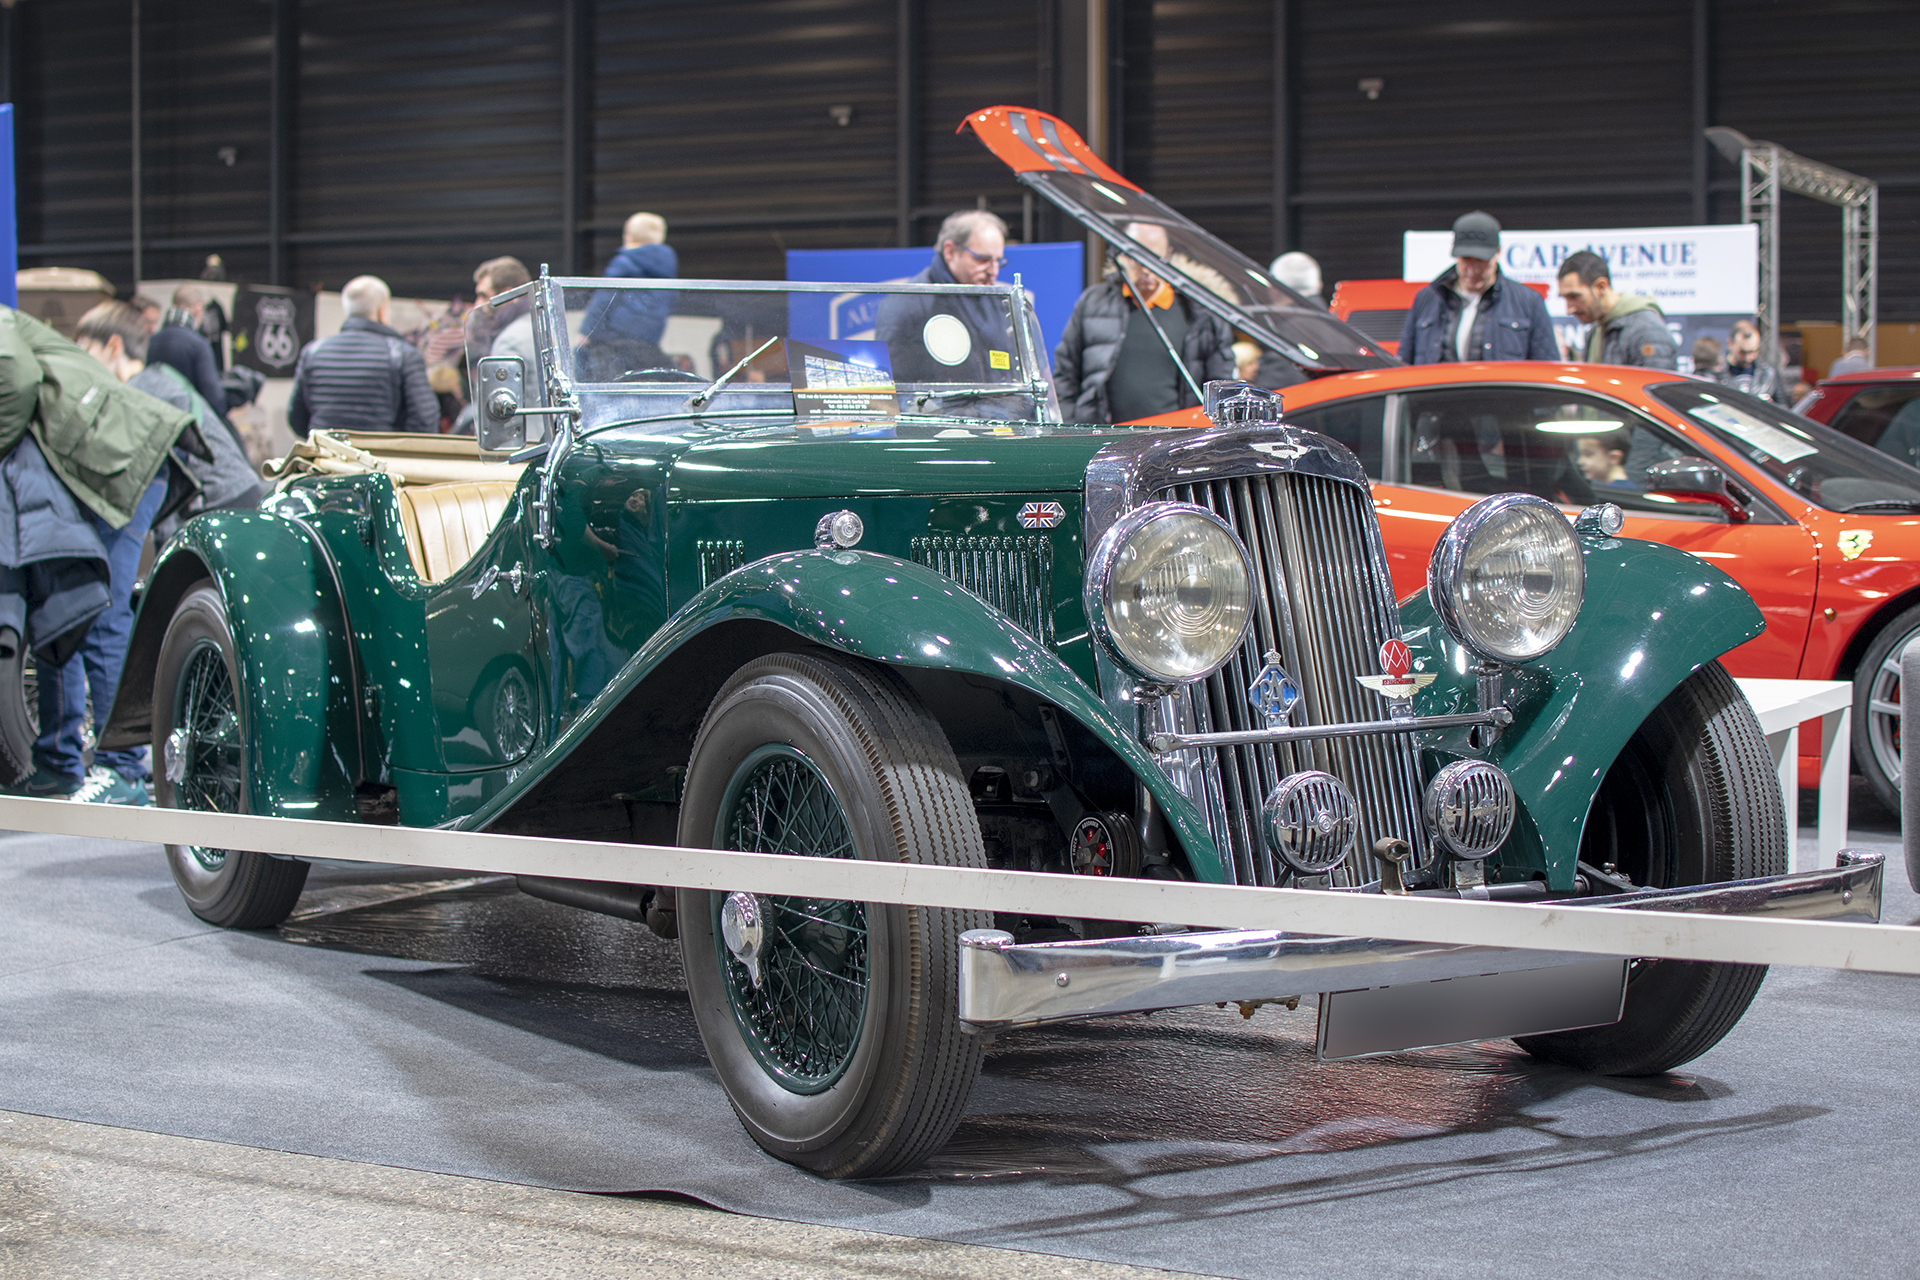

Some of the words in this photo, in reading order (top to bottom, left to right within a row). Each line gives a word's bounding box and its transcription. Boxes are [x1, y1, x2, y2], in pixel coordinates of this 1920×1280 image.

[1507, 243, 1568, 268] CAR
[262, 325, 292, 357] 66
[1259, 671, 1292, 713] RAC
